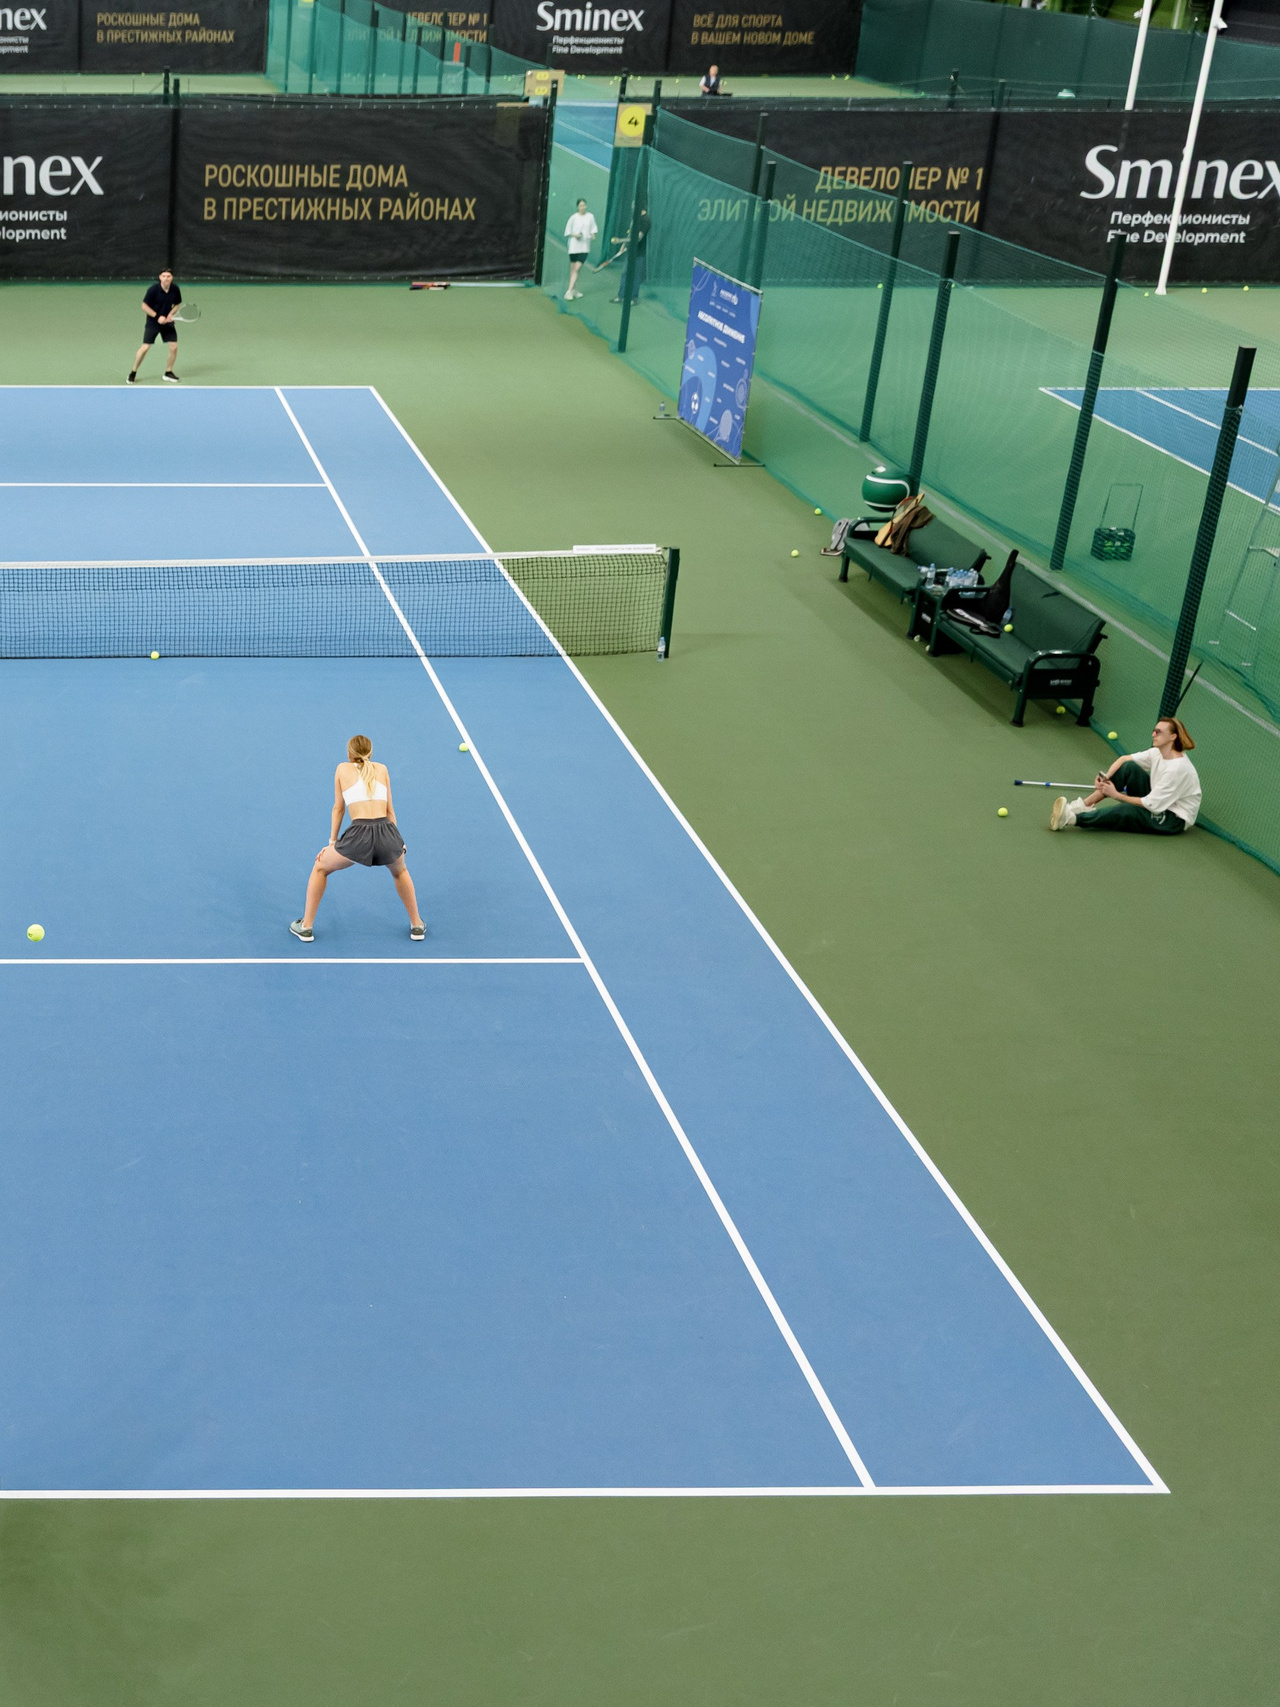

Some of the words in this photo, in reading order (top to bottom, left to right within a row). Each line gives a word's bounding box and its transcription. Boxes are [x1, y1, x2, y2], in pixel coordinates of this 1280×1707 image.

[96, 12, 166, 27] РОСКОШНЫЕ
[168, 12, 200, 28] ДОМА
[536, 1, 645, 31] Sminex
[693, 11, 715, 28] ВСЁ
[715, 13, 739, 29] ДЛЯ
[741, 14, 783, 28] СПОРТА
[96, 30, 105, 44] В
[107, 29, 183, 44] ПРЕСТИЖНЫХ
[185, 27, 236, 44] РАЙОНАХ
[691, 31, 699, 45] В
[701, 31, 741, 45] ВАШЕМ
[743, 31, 782, 45] НОВОМ
[782, 31, 815, 47] ДОМЕ
[627, 115, 640, 127] 4
[205, 164, 341, 188] РОСКОШНЫЕ
[346, 164, 409, 191] ДОМА
[946, 166, 970, 191] №
[976, 166, 984, 191] 1
[1079, 144, 1280, 200] Smnex
[204, 197, 217, 221] В
[223, 197, 373, 221] ПРЕСТИЖНЫХ
[379, 192, 477, 221] РАЙОНАХ
[801, 199, 980, 226] НЕДВИЖМОСТИ
